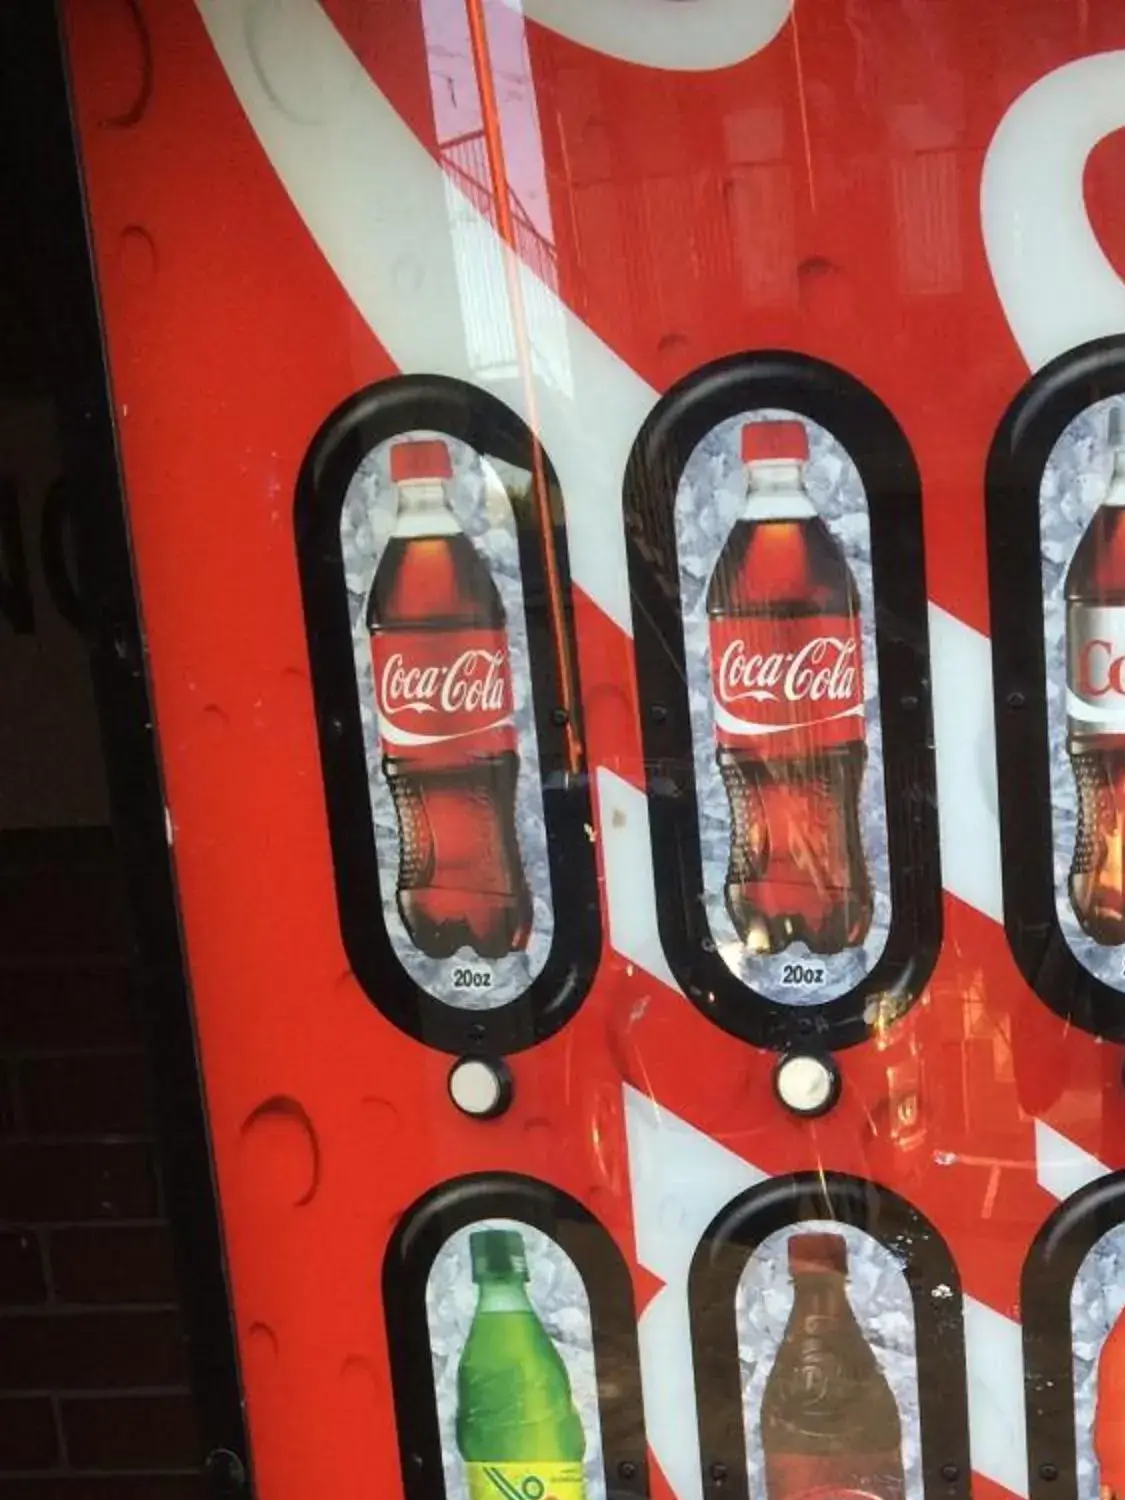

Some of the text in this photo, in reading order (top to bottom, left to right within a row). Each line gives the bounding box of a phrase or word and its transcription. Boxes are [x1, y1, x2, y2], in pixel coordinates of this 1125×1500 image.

[381, 649, 506, 715] Coca-Cola
[719, 637, 857, 703] Coca-Cola
[453, 969, 492, 988] 20oz
[783, 964, 824, 985] 20oz
